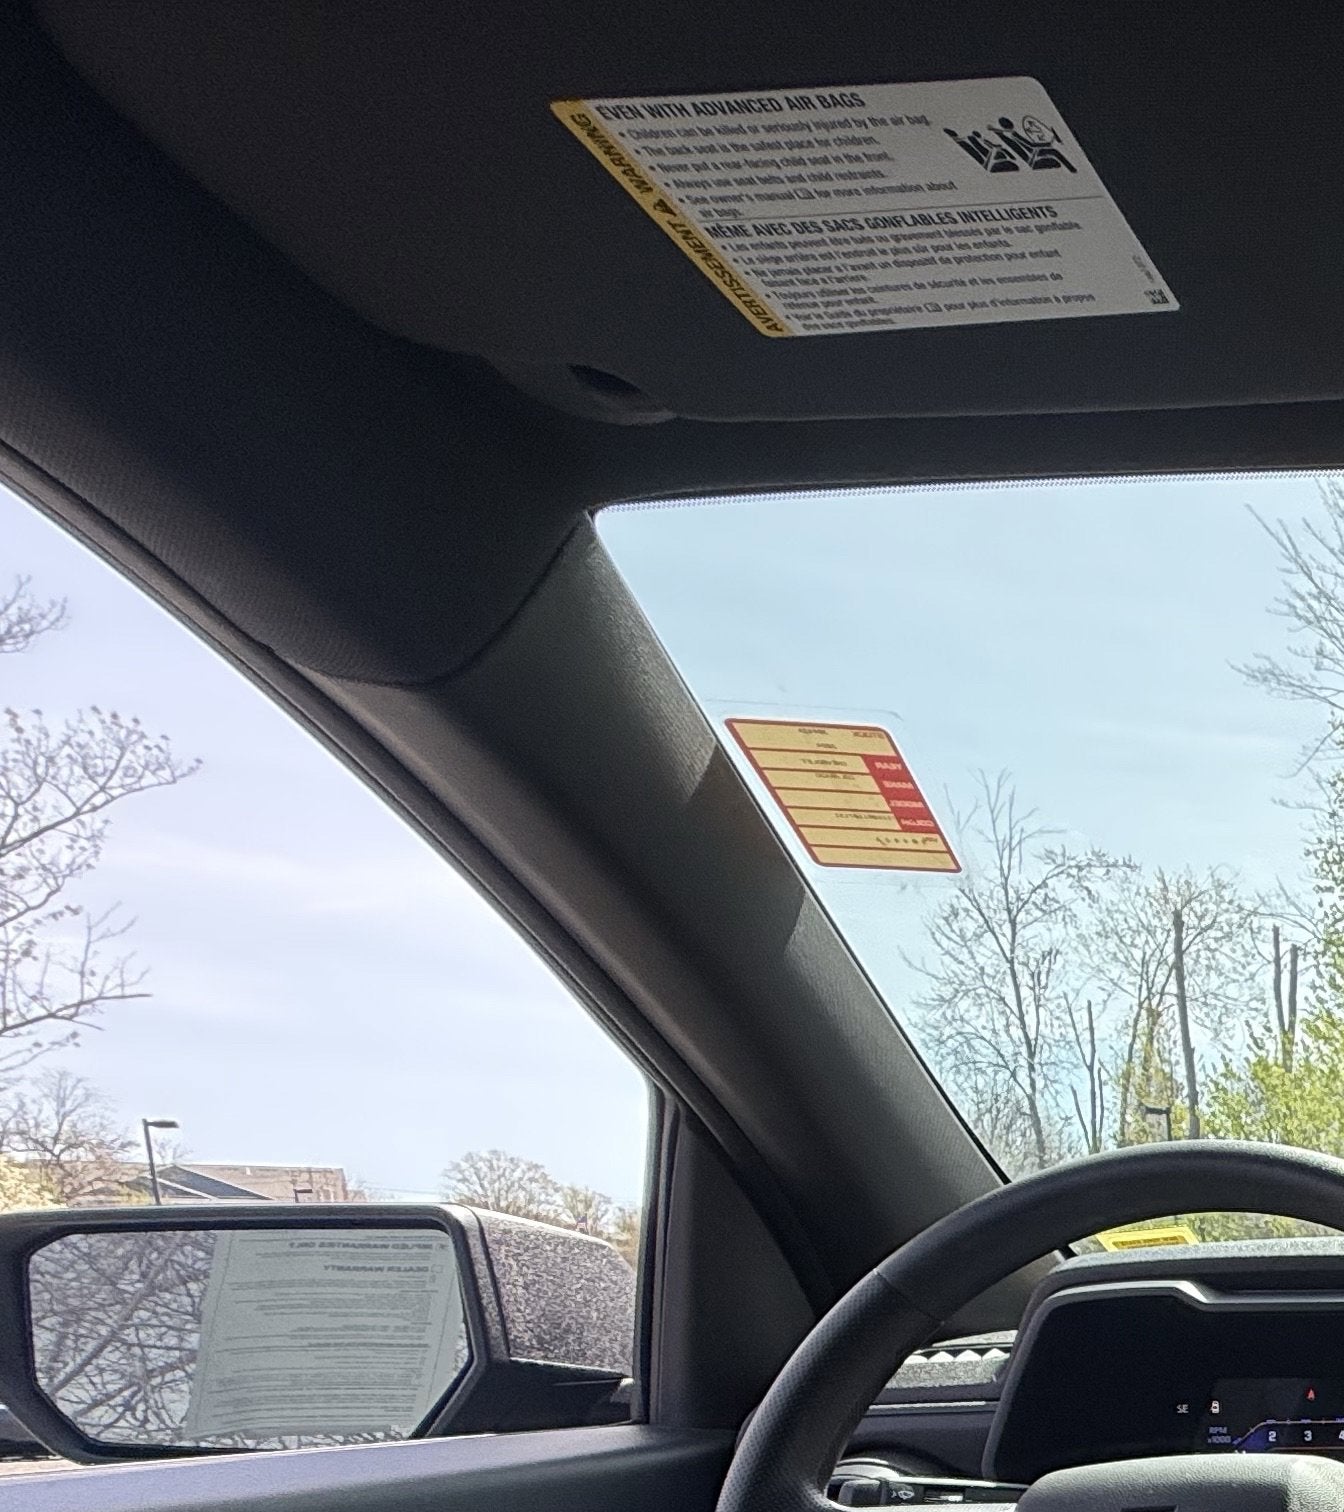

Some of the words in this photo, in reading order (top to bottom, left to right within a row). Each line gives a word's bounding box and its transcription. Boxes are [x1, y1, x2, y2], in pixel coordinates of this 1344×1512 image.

[595, 104, 645, 120] EVEN
[642, 102, 692, 119] WITH
[689, 97, 784, 116] ADVANCED
[782, 95, 817, 110] AIR
[815, 92, 866, 109] BAGS
[570, 112, 655, 195] WARNING
[703, 224, 753, 239] MÊME
[750, 222, 792, 236] AVEC
[790, 220, 824, 234] DES
[821, 218, 865, 232] SACS
[862, 212, 958, 229] GONFLABLES
[956, 205, 1058, 223] INTELLIGENTS
[668, 219, 786, 334] AVERTISSEMENT
[1176, 1404, 1189, 1414] SE
[1268, 1431, 1277, 1442] 2
[1304, 1430, 1313, 1441] 3
